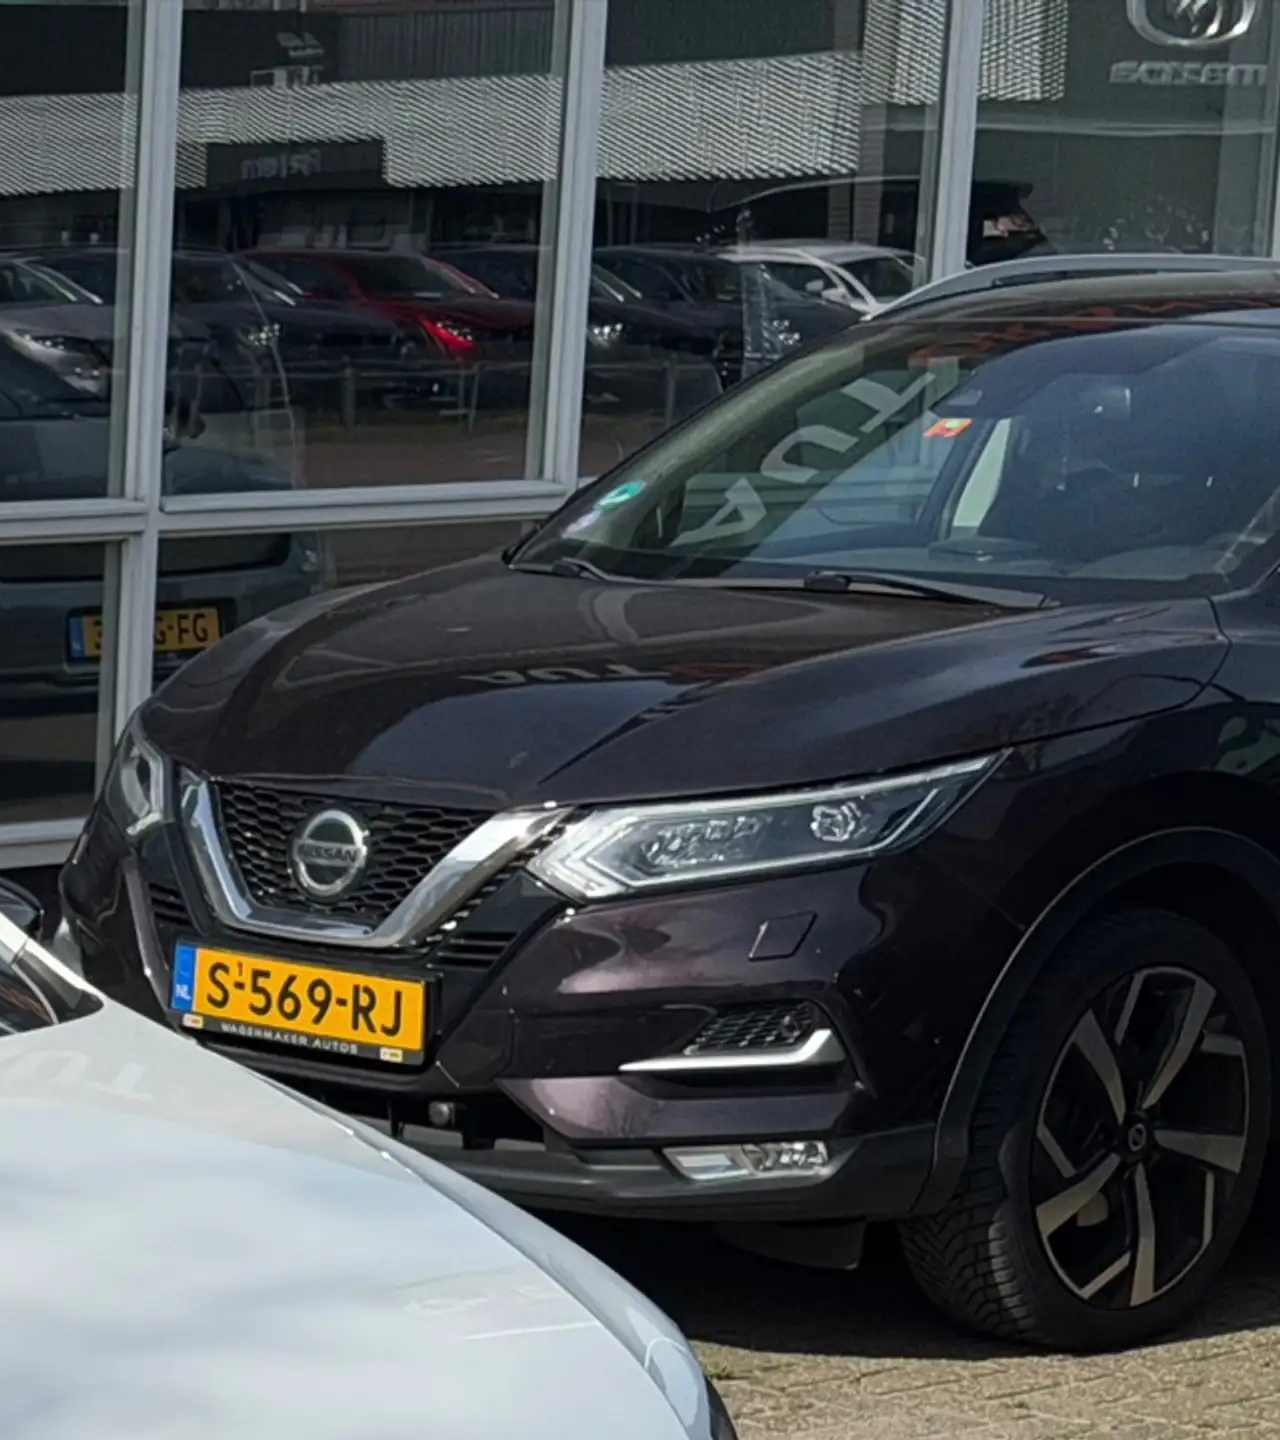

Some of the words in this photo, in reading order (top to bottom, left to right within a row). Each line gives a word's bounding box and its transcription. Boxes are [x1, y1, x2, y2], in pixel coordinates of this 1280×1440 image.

[297, 843, 358, 863] NISSAN
[175, 982, 192, 1003] NL
[206, 960, 403, 1038] S-569-RJ
